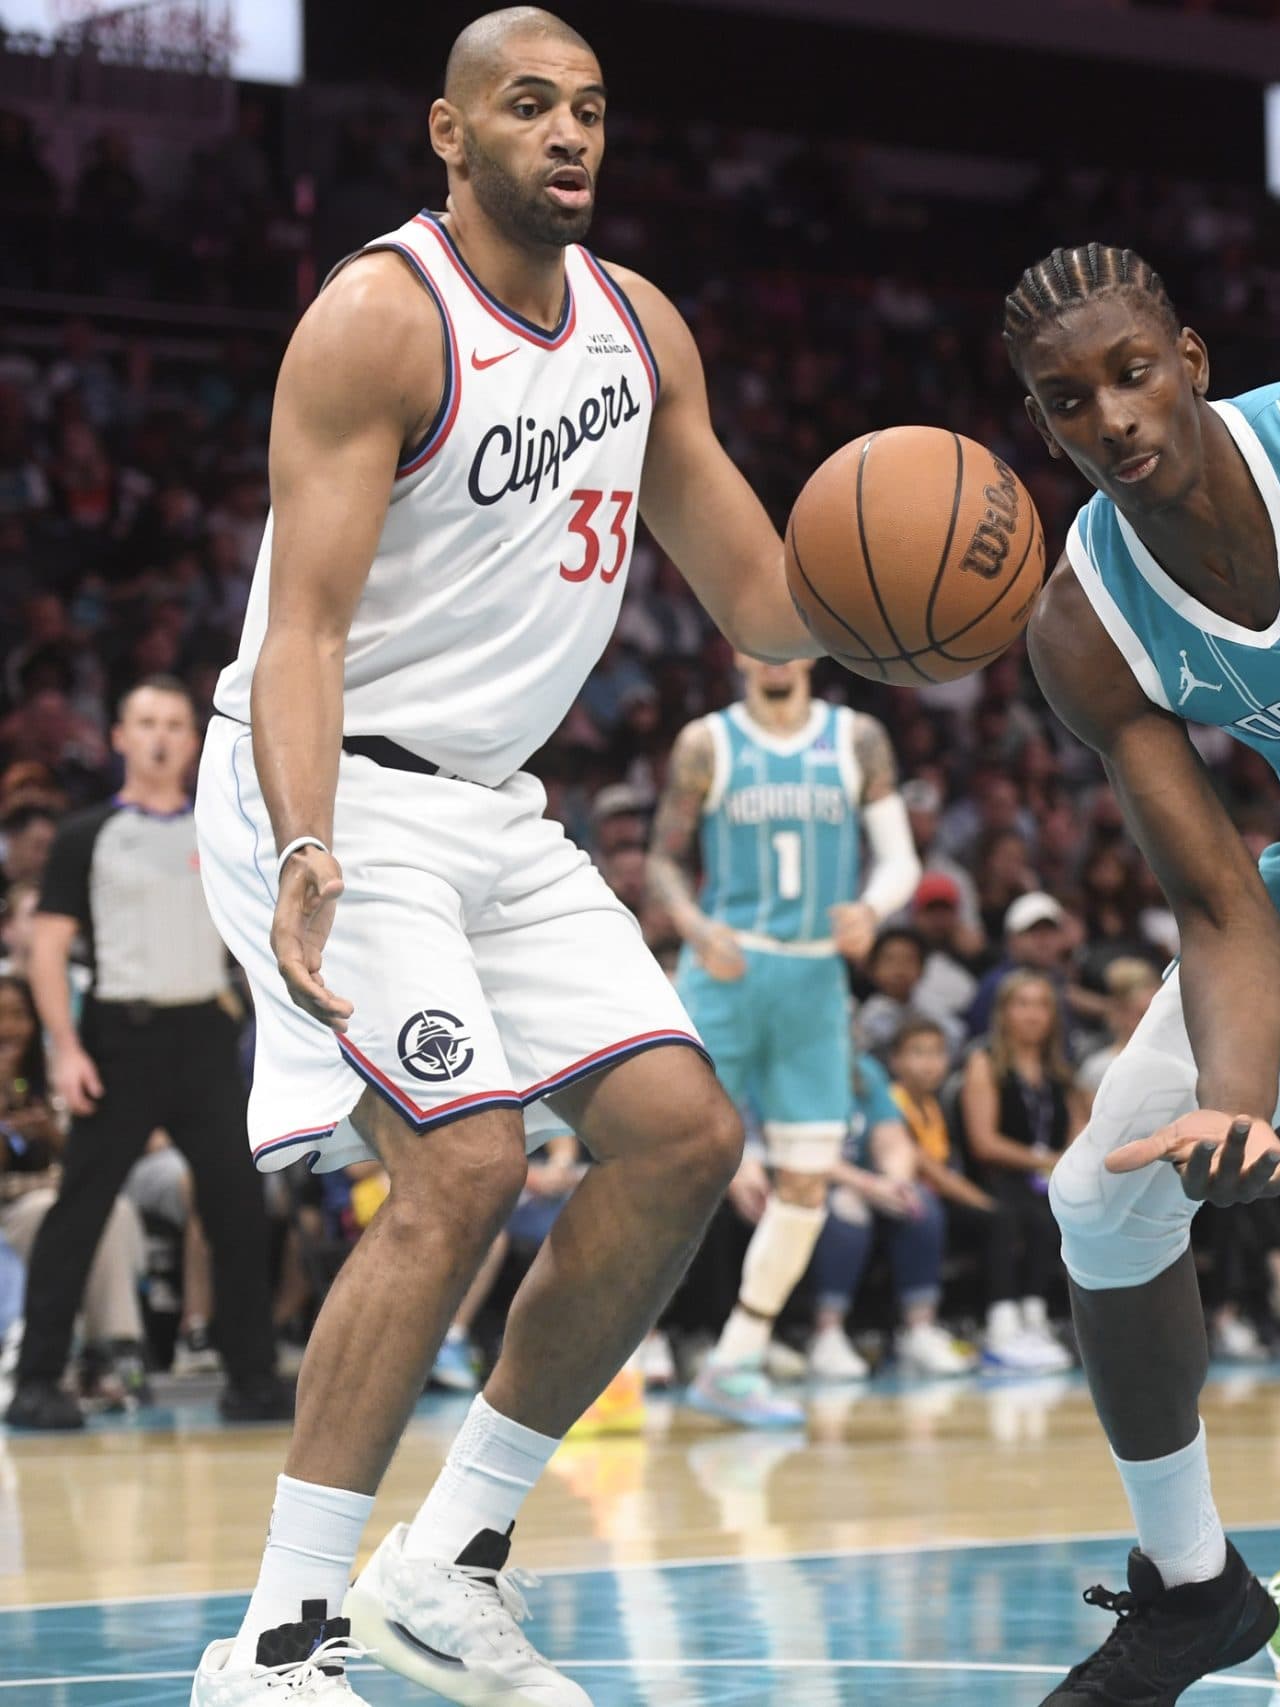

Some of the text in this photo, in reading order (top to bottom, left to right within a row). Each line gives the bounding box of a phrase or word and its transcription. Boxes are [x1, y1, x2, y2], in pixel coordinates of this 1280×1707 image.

[585, 344, 633, 354] RWANDA
[588, 333, 615, 344] VISIT
[468, 374, 641, 506] Clippers
[559, 489, 634, 584] 33
[771, 830, 801, 899] 1
